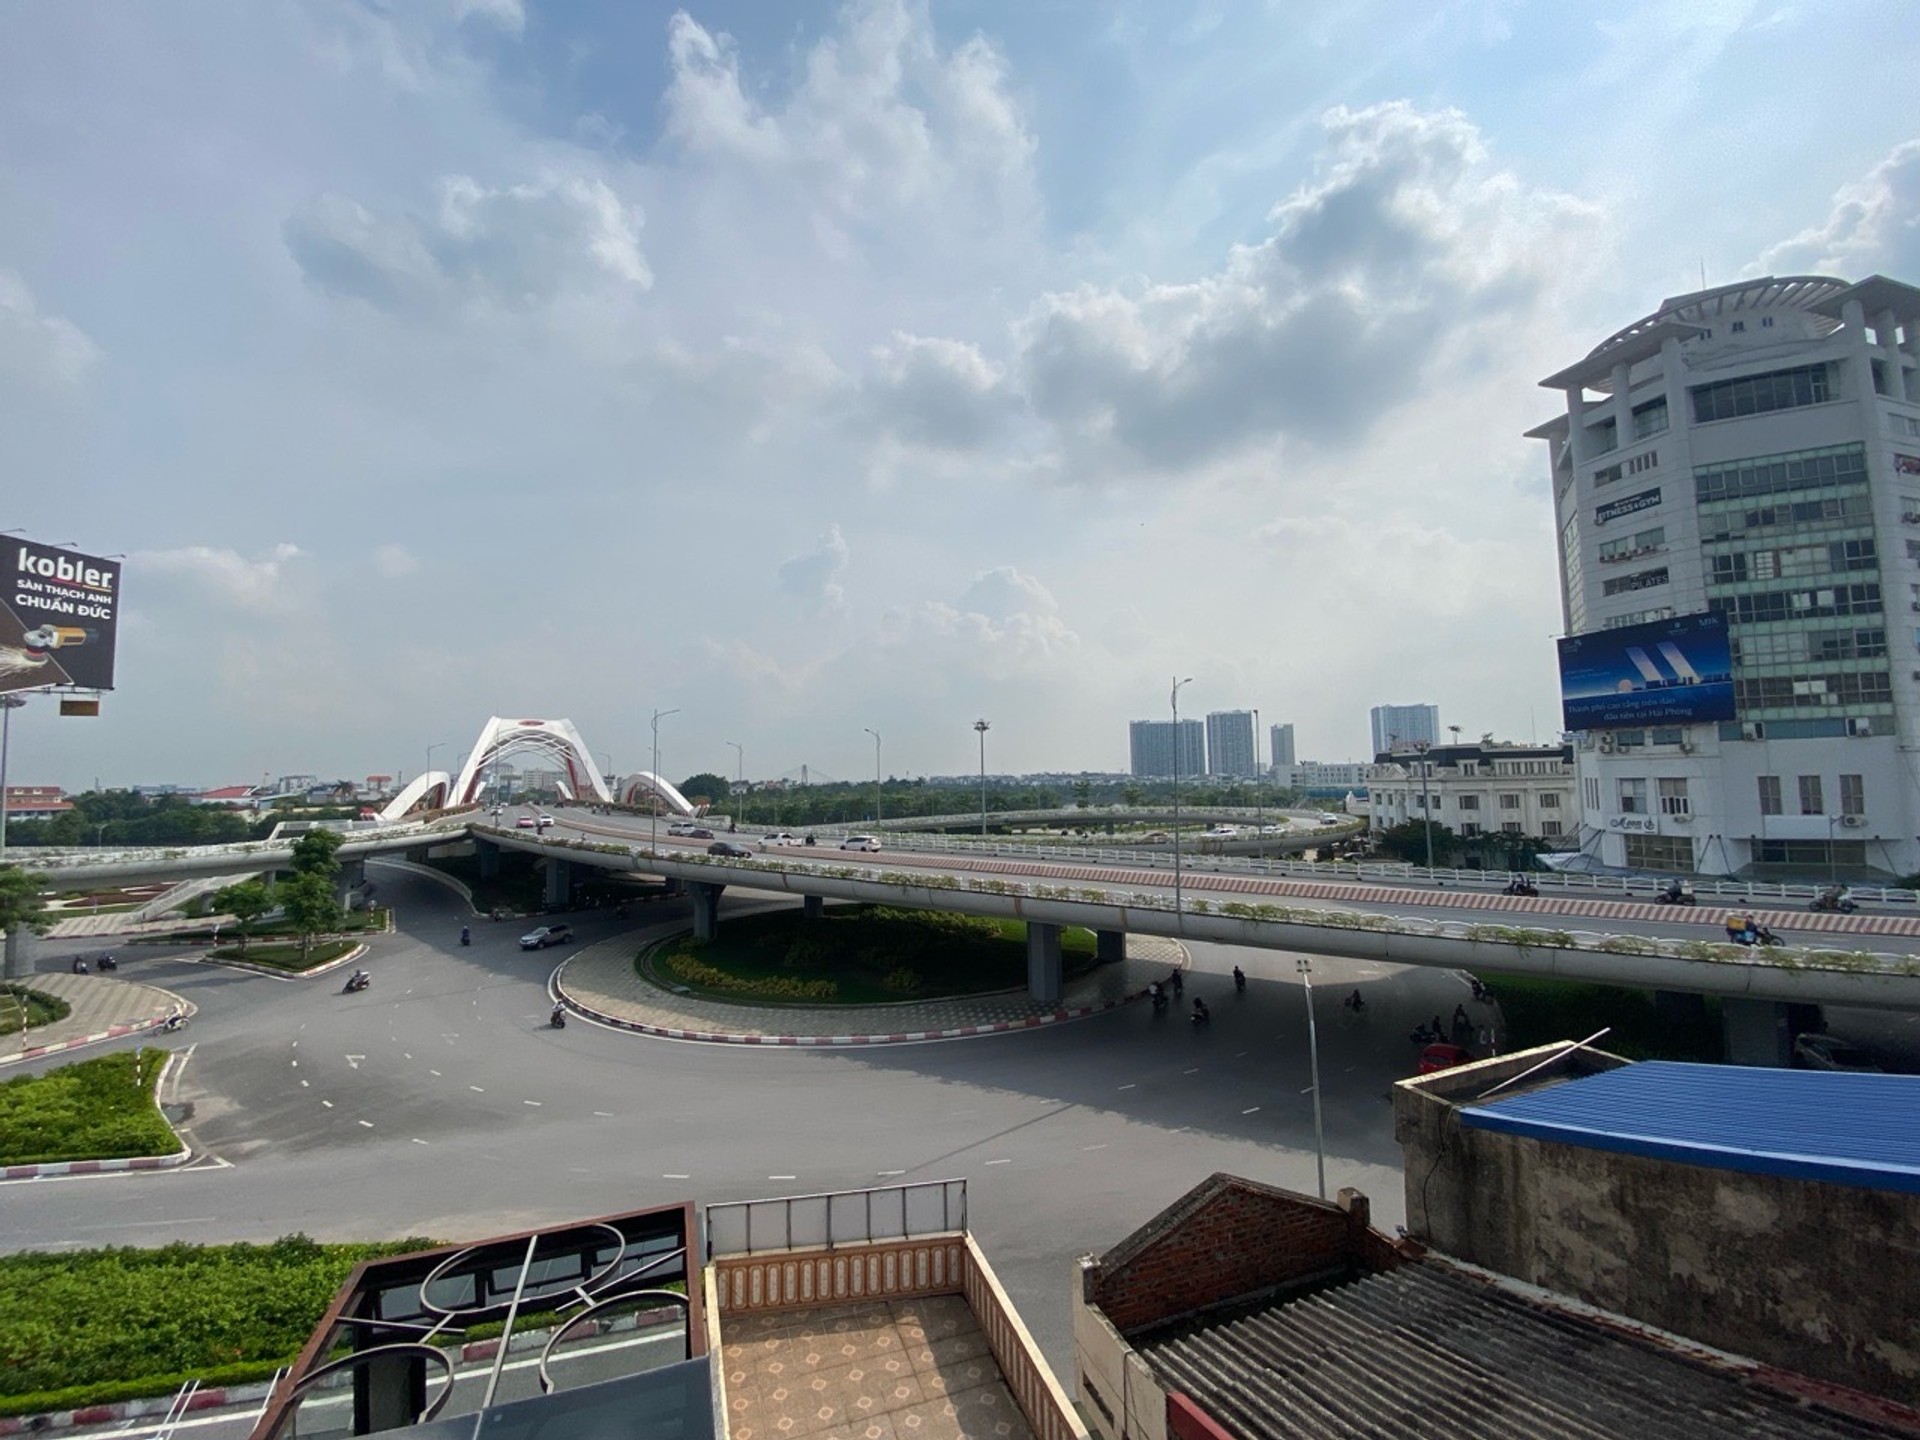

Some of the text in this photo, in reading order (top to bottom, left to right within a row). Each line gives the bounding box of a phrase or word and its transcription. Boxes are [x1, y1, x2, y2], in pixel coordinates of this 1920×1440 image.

[1638, 495, 1660, 508] GYM
[18, 547, 113, 588] kobler
[1630, 574, 1668, 590] PILATES
[17, 579, 112, 604] SÀN THẠCH ANH
[77, 604, 111, 619] ĐỨC
